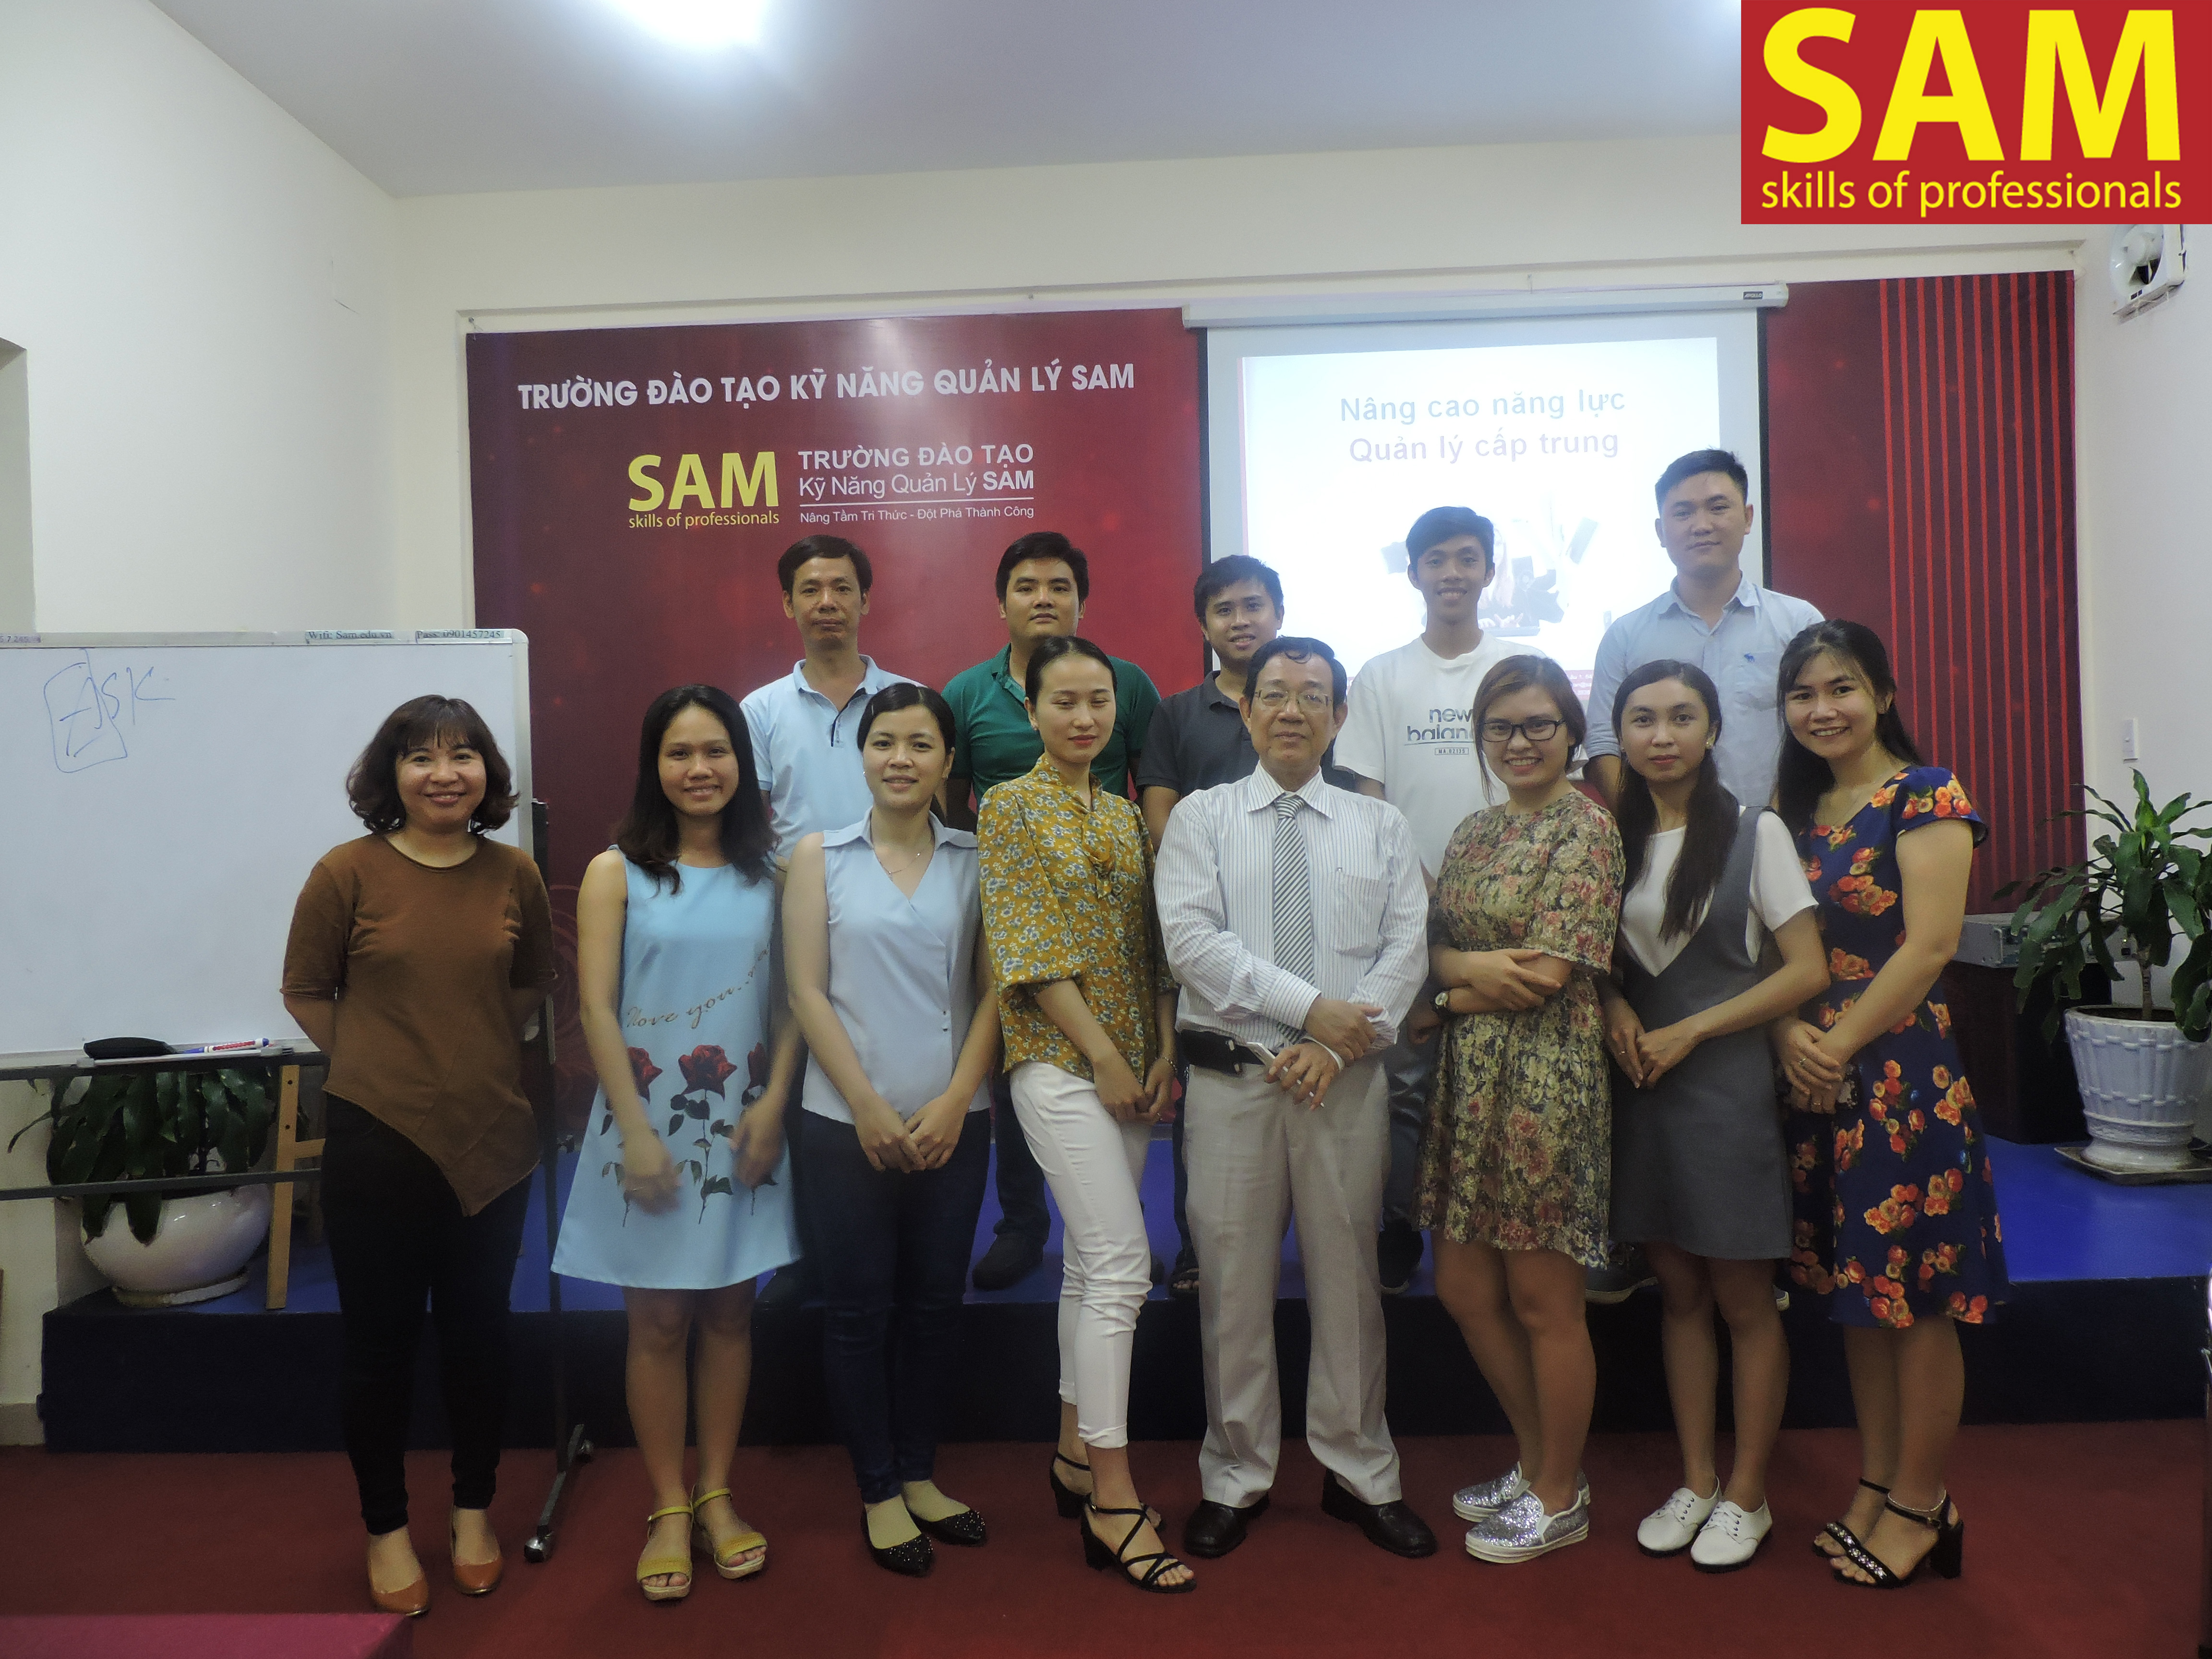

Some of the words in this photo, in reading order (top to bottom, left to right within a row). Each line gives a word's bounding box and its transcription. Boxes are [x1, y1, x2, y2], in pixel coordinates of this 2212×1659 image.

[518, 375, 637, 409] TRƯỜNG
[647, 371, 712, 405] ĐÀO
[721, 376, 780, 409] TẠO
[790, 368, 827, 400] KỸ
[837, 366, 924, 398] NĂNG
[934, 359, 1020, 395] QUẢN
[1031, 358, 1062, 391] LÝ
[1071, 363, 1134, 390] SAM
[1341, 397, 1416, 425] Nâng
[1428, 399, 1479, 418] cao
[1492, 391, 1564, 419] năng
[1579, 389, 1625, 418] lực
[798, 445, 910, 470] TRƯỜNG
[917, 442, 973, 466] ĐÀO
[981, 444, 1034, 469] TẠO
[1349, 436, 1427, 462] Quản
[1440, 434, 1464, 464] lý
[1475, 427, 1527, 462] cấp
[1539, 433, 1618, 458] trung
[628, 451, 779, 511] SAM
[800, 477, 826, 501] Kỹ
[832, 476, 885, 499] Năng
[891, 473, 947, 493] Quản
[953, 472, 977, 496] Lý
[983, 470, 1034, 491] SAM
[629, 514, 663, 528] skills
[667, 512, 682, 527] of
[685, 510, 780, 529] professionals
[800, 512, 830, 525] Nâng
[833, 509, 858, 522] Tầm
[878, 508, 907, 520] Thức
[917, 508, 937, 521] Đột
[940, 507, 962, 518] Phá
[965, 506, 1001, 517] Thành
[1004, 505, 1034, 518] Công
[1429, 708, 1473, 723] new
[1407, 724, 1473, 741] balan
